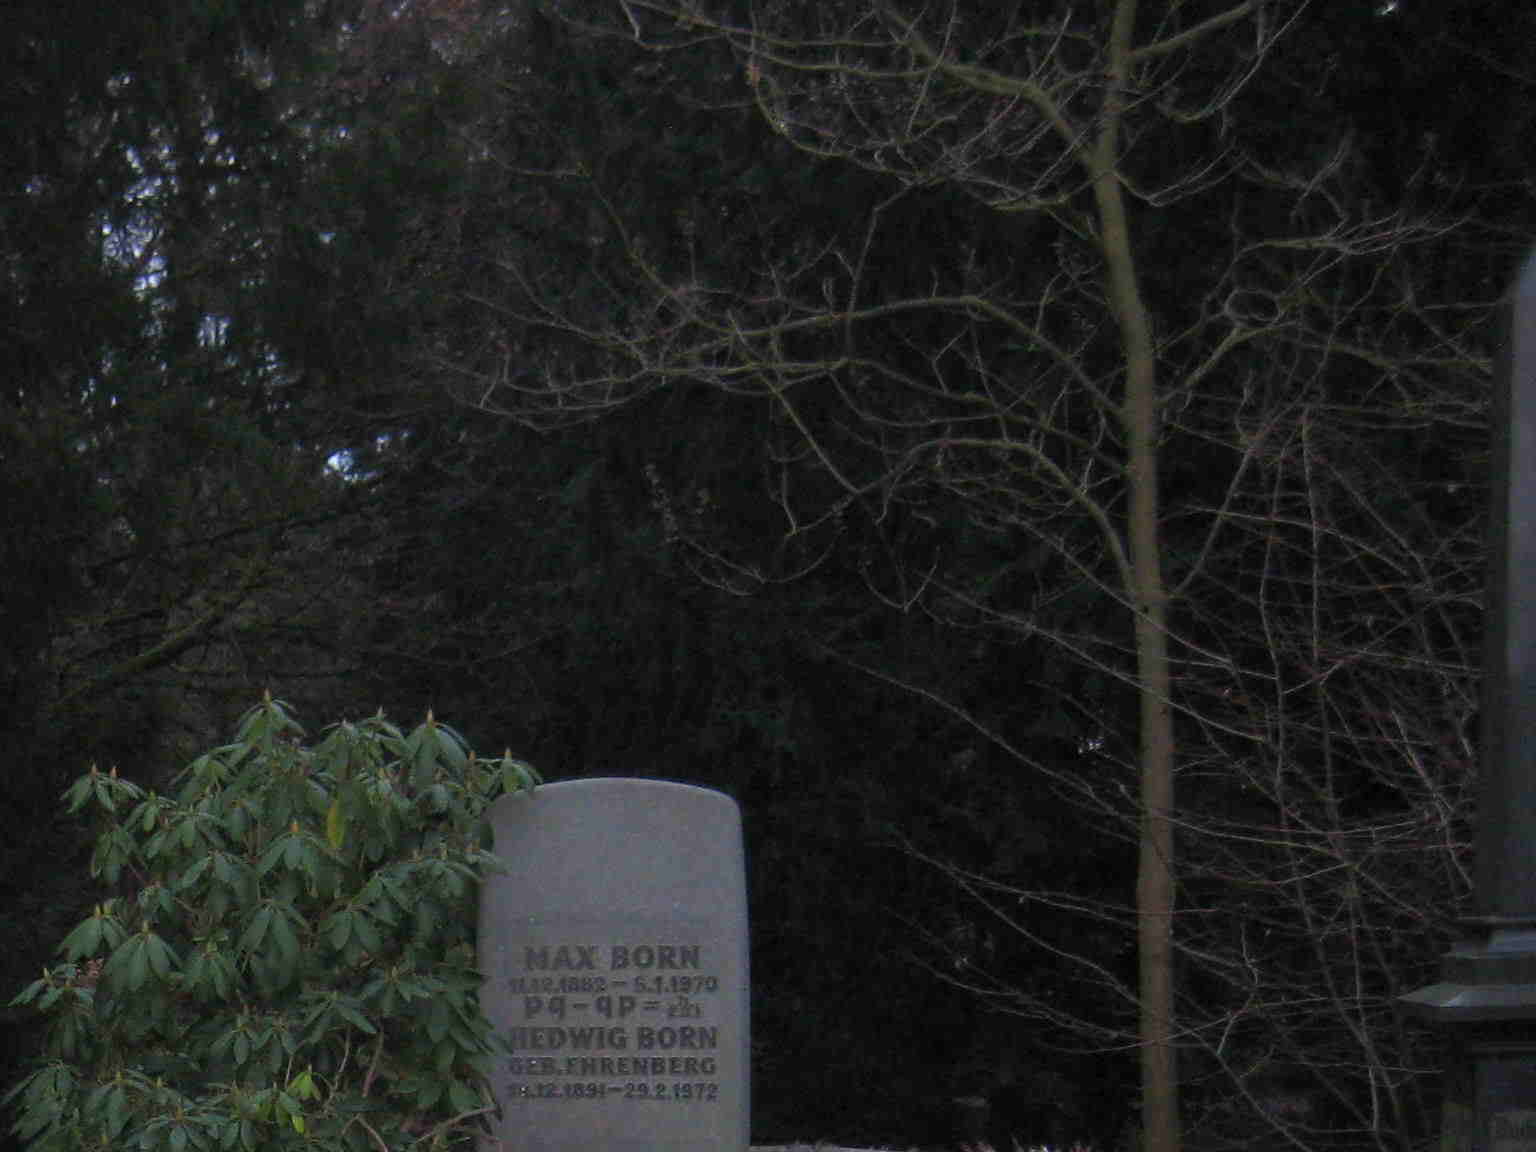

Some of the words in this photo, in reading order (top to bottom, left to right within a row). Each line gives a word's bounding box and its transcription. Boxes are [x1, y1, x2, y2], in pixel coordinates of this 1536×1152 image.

[524, 945, 598, 970] MAX
[611, 945, 702, 970] BORN
[512, 1026, 630, 1050] HEDWIG
[636, 1026, 719, 1050] BORN
